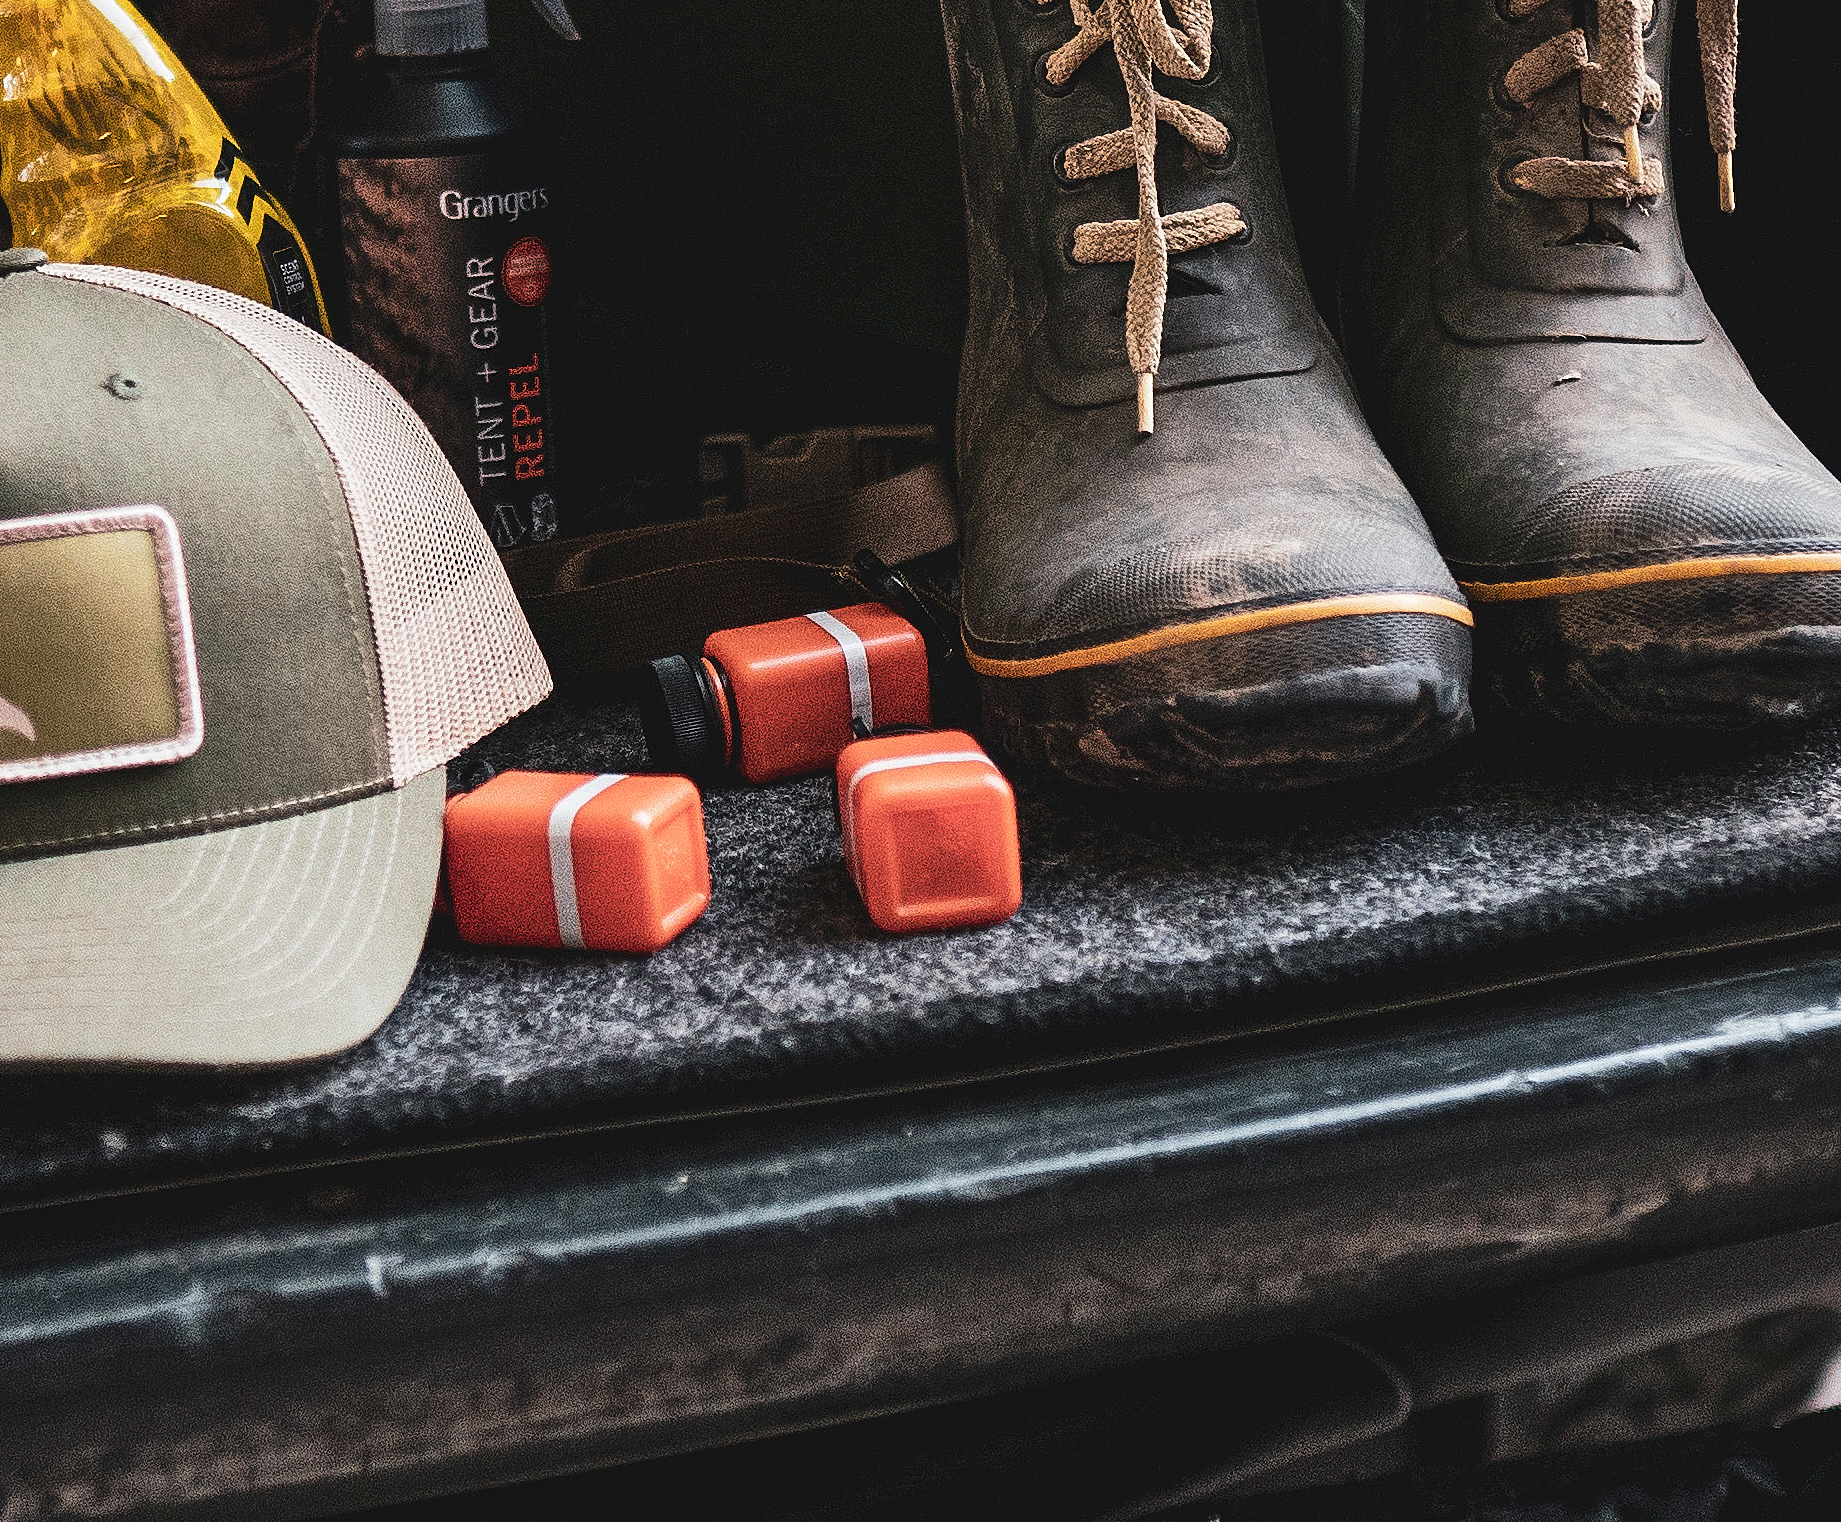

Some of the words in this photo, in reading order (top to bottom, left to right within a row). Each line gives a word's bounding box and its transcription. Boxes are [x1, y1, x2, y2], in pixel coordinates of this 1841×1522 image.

[439, 186, 549, 222] Grangers
[280, 259, 299, 275] SCENT
[466, 256, 500, 350] GEAR
[475, 397, 507, 486] TENT
[508, 353, 545, 481] REPEL
